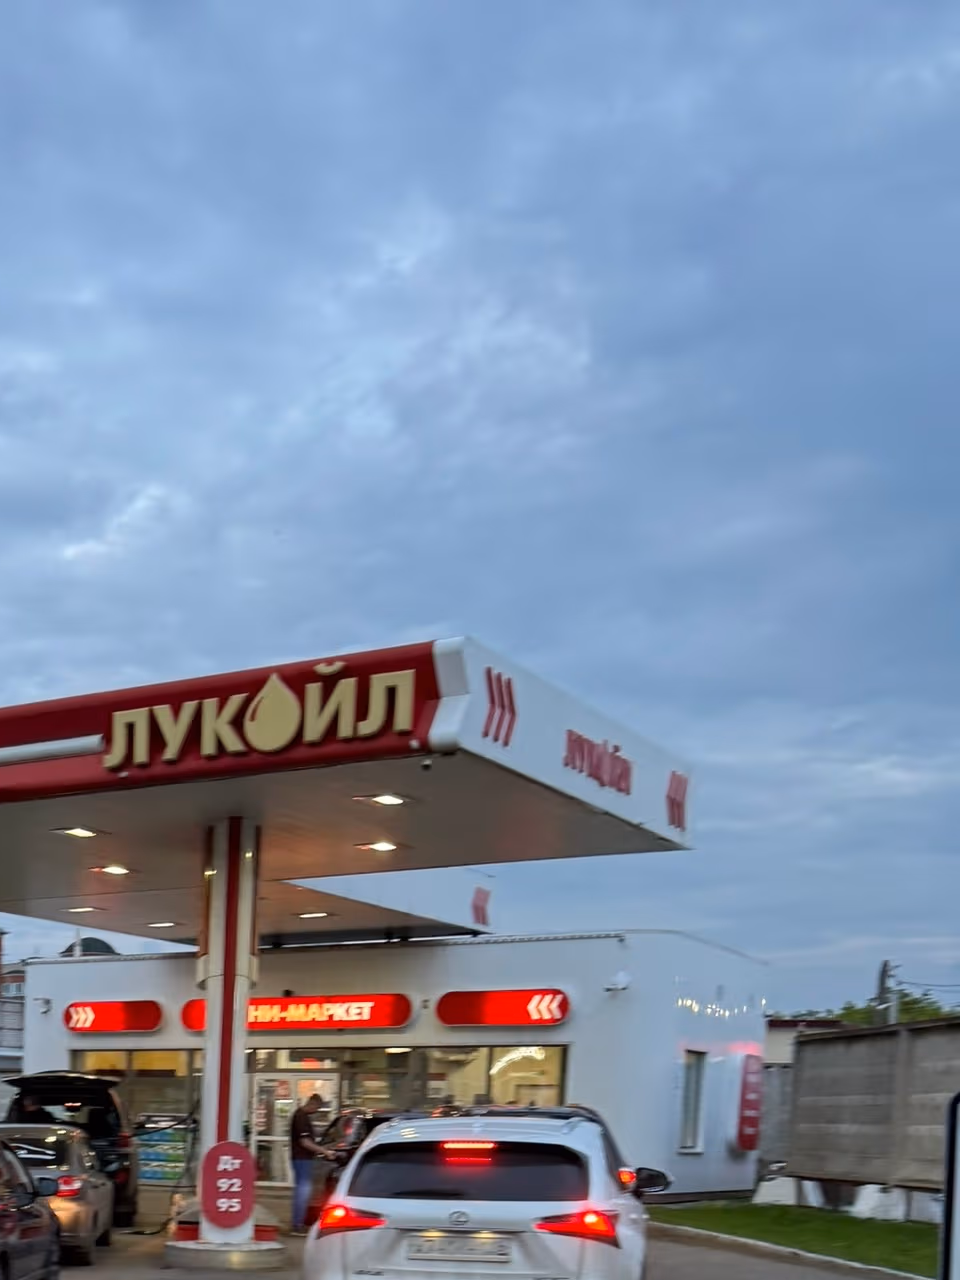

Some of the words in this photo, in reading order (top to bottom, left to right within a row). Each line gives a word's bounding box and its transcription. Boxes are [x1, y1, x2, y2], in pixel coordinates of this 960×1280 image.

[102, 661, 415, 768] ЛУКОЙЛ
[247, 1002, 374, 1023] НИ-МАРКЕТ
[216, 1178, 243, 1193] 92
[216, 1198, 242, 1213] 95
